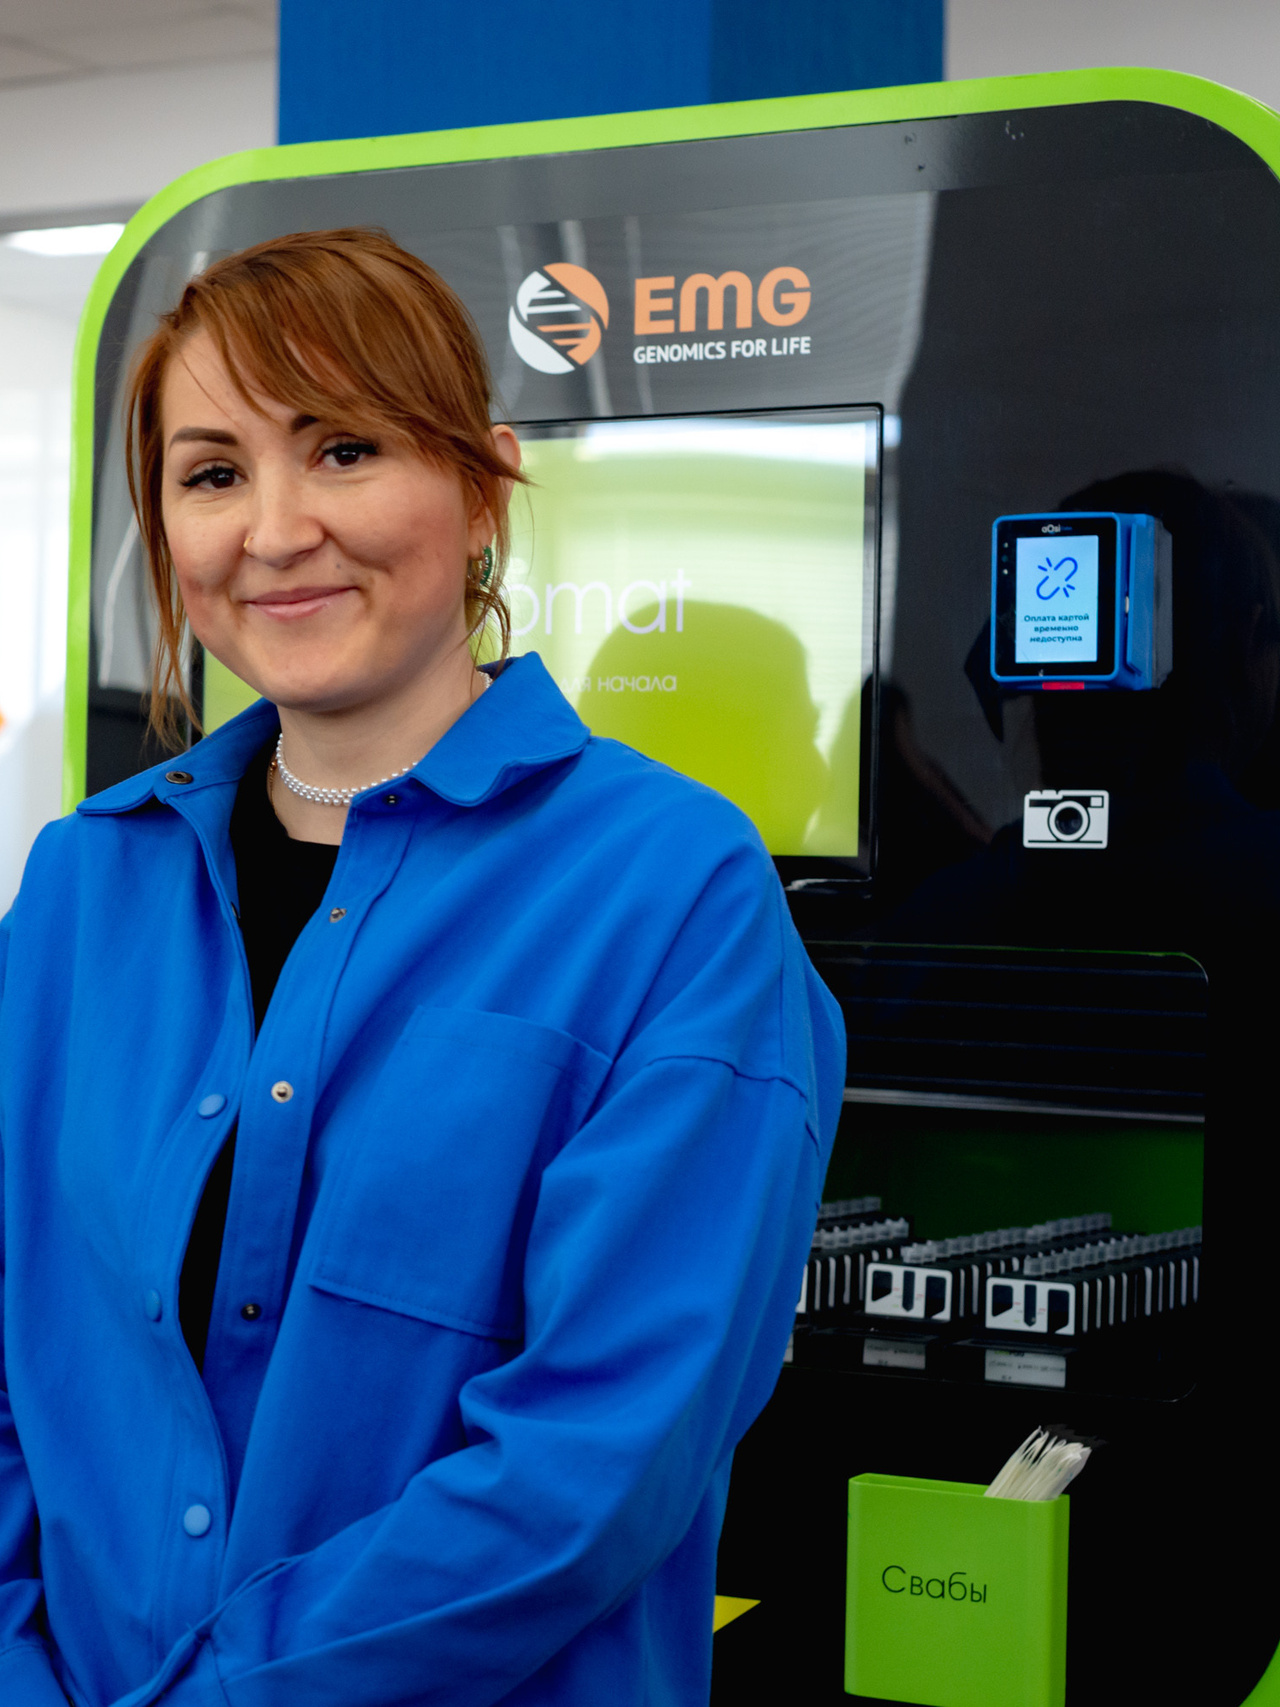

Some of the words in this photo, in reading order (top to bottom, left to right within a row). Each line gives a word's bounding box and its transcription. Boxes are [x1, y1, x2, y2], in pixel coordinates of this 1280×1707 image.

[634, 266, 812, 336] EMG
[632, 341, 727, 365] GENOMICS
[730, 338, 768, 360] FOR
[771, 336, 812, 356] LIFE
[486, 567, 692, 637] omat
[1023, 614, 1056, 622] Оплата
[1058, 612, 1090, 622] картой
[1029, 635, 1083, 644] недоступна
[1034, 625, 1079, 634] временно
[597, 674, 678, 693] начала
[881, 1565, 988, 1604] Свабы
